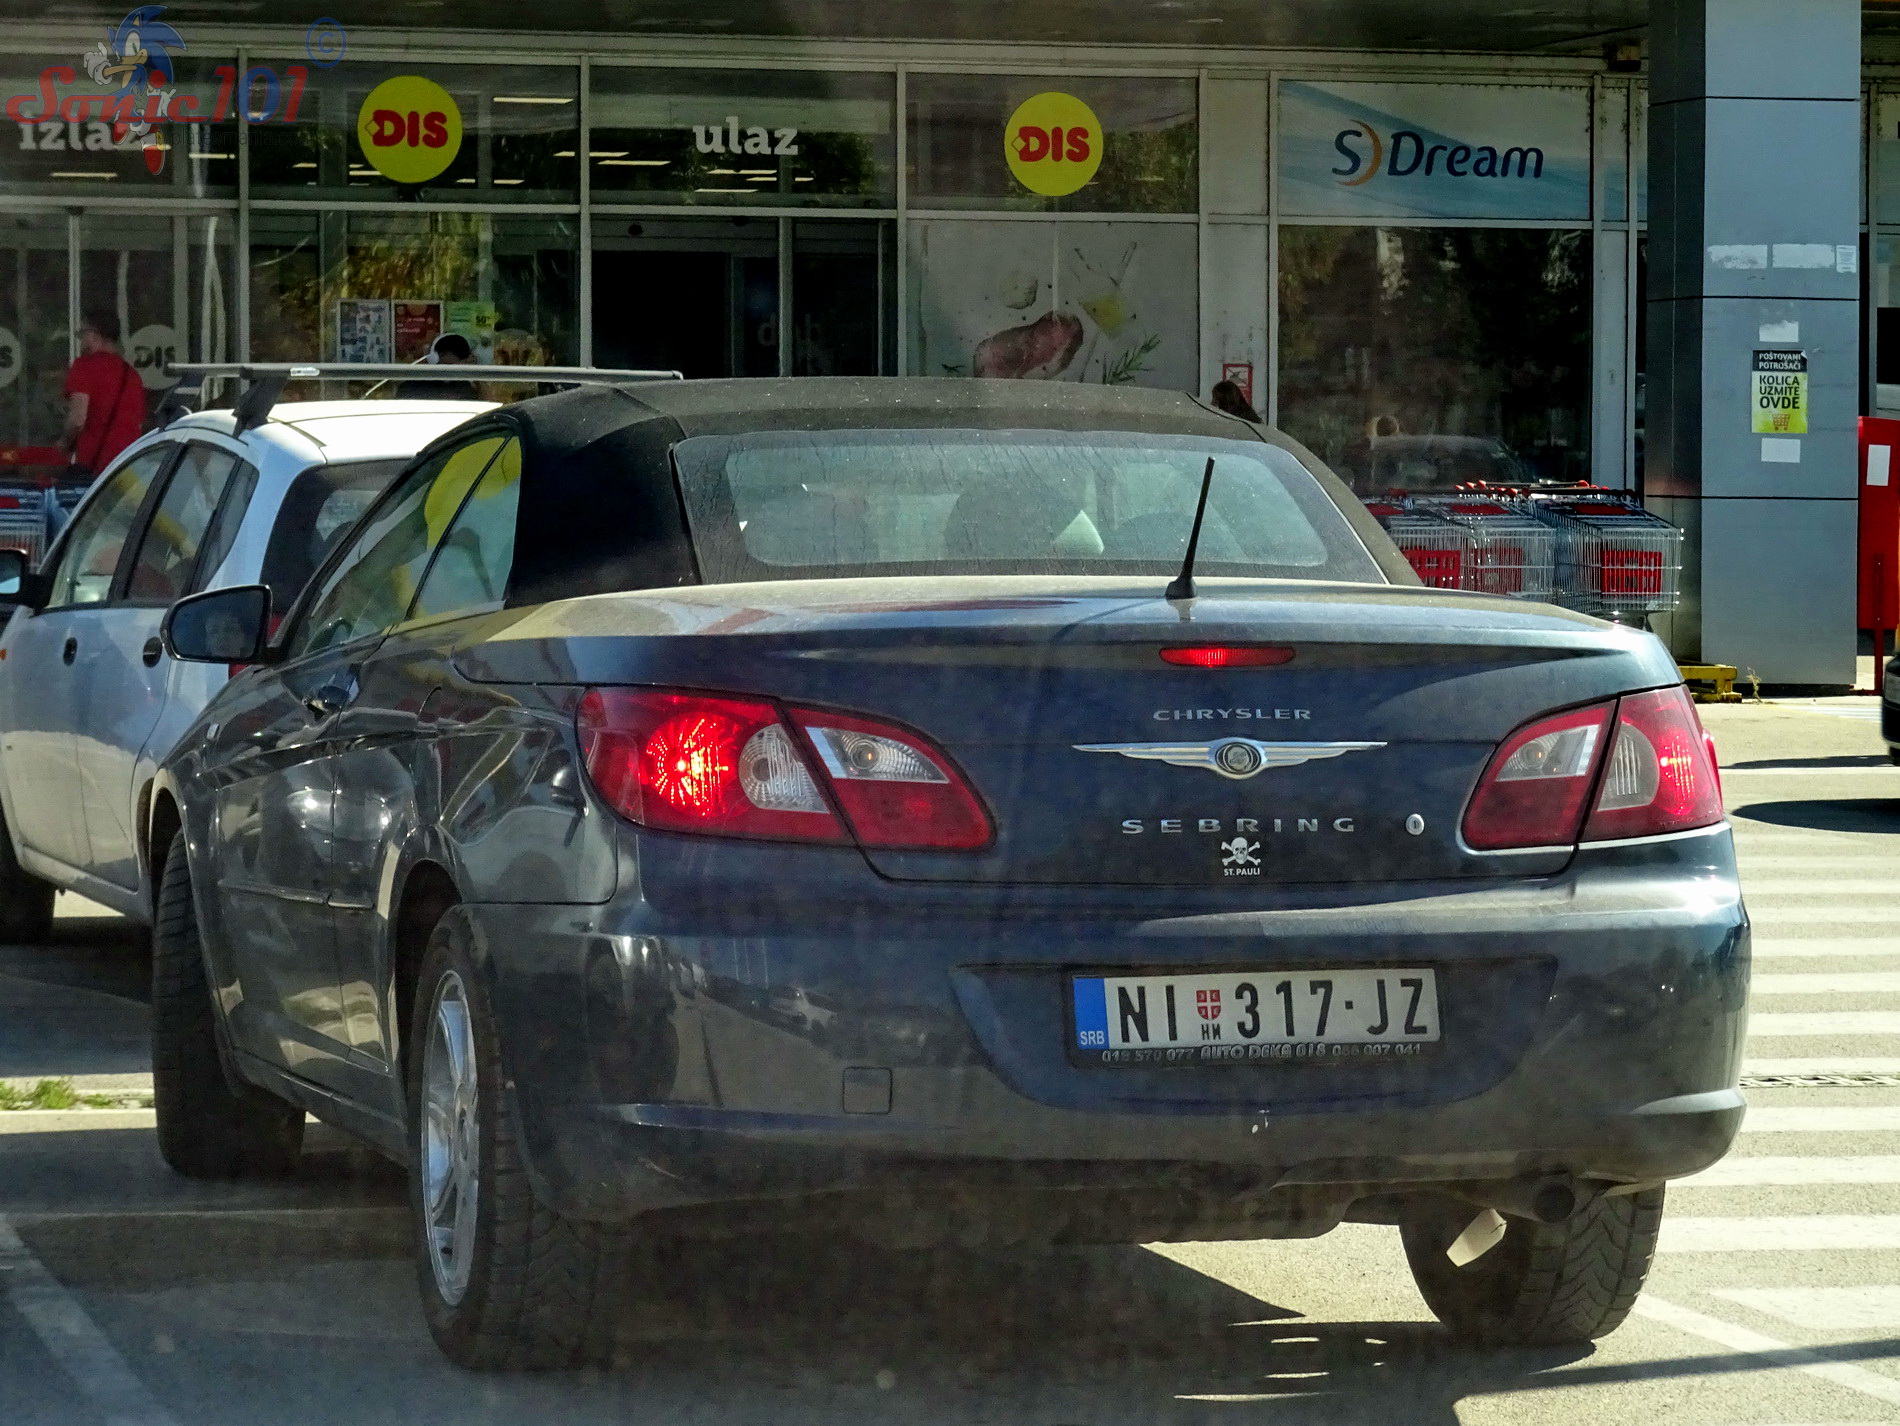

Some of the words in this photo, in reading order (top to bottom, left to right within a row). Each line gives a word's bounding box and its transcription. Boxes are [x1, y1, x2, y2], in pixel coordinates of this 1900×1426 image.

[368, 109, 448, 149] DIS
[693, 116, 799, 155] ulaz
[1016, 126, 1091, 163] DIS
[1758, 351, 1801, 361] POŠTOVANI
[1758, 361, 1801, 370] POTROŠAČI
[1759, 374, 1800, 386] KOLICA
[1759, 385, 1800, 396] UZMITE
[1759, 395, 1800, 409] OVDE
[1152, 708, 1312, 721] CHRYSLER
[1121, 817, 1355, 835] SEBRING
[1117, 984, 1178, 1043] NI
[1080, 1030, 1106, 1046] SRB
[1200, 1044, 1245, 1060] AUTO
